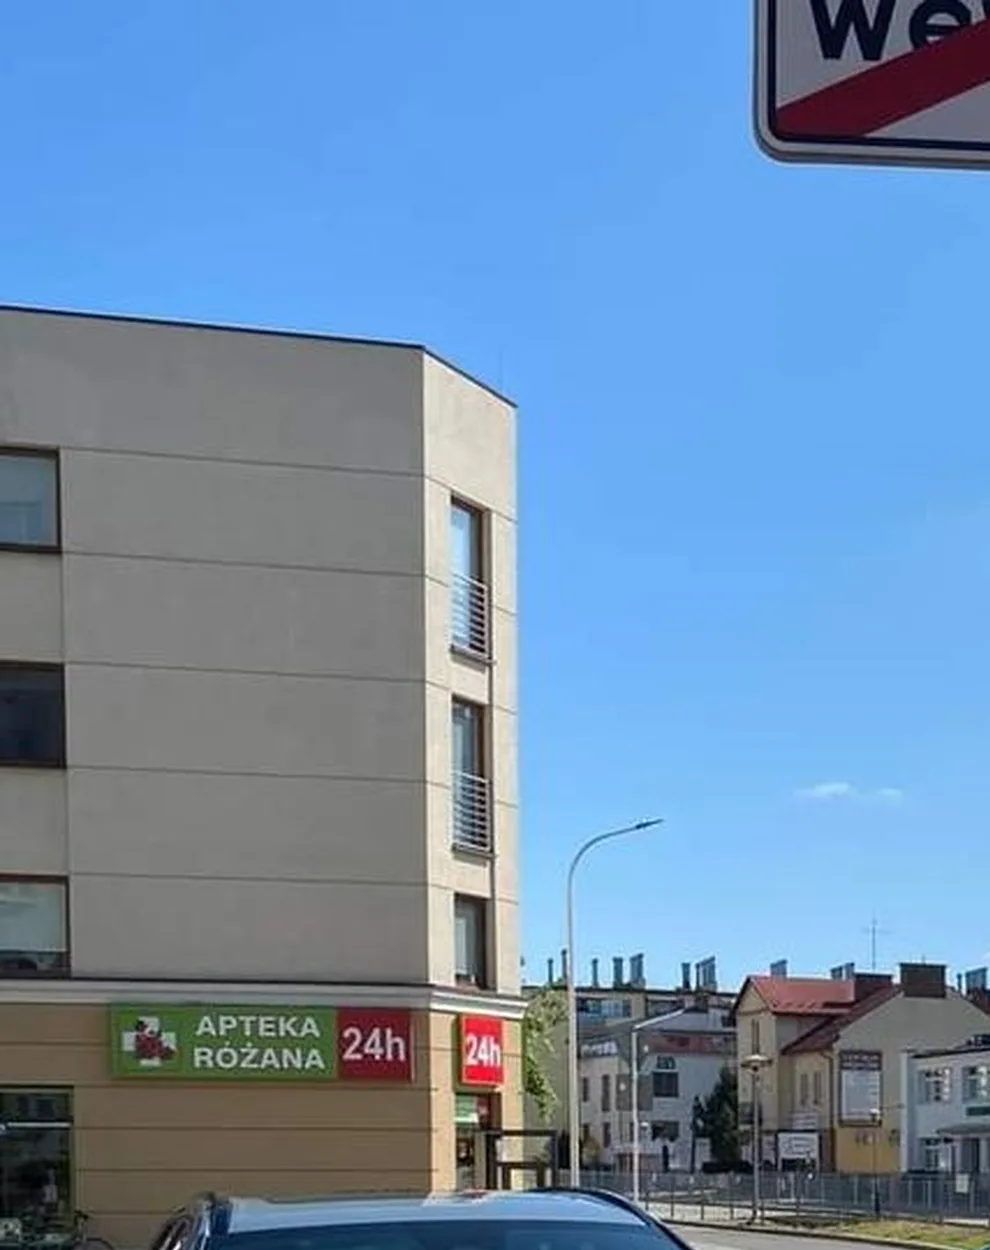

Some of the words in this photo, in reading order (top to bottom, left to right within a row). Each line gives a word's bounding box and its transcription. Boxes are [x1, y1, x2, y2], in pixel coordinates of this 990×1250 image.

[194, 1015, 321, 1038] APTEKA
[194, 1042, 326, 1070] RÓŻANA
[341, 1027, 406, 1061] 24h
[465, 1033, 501, 1066] 24h
